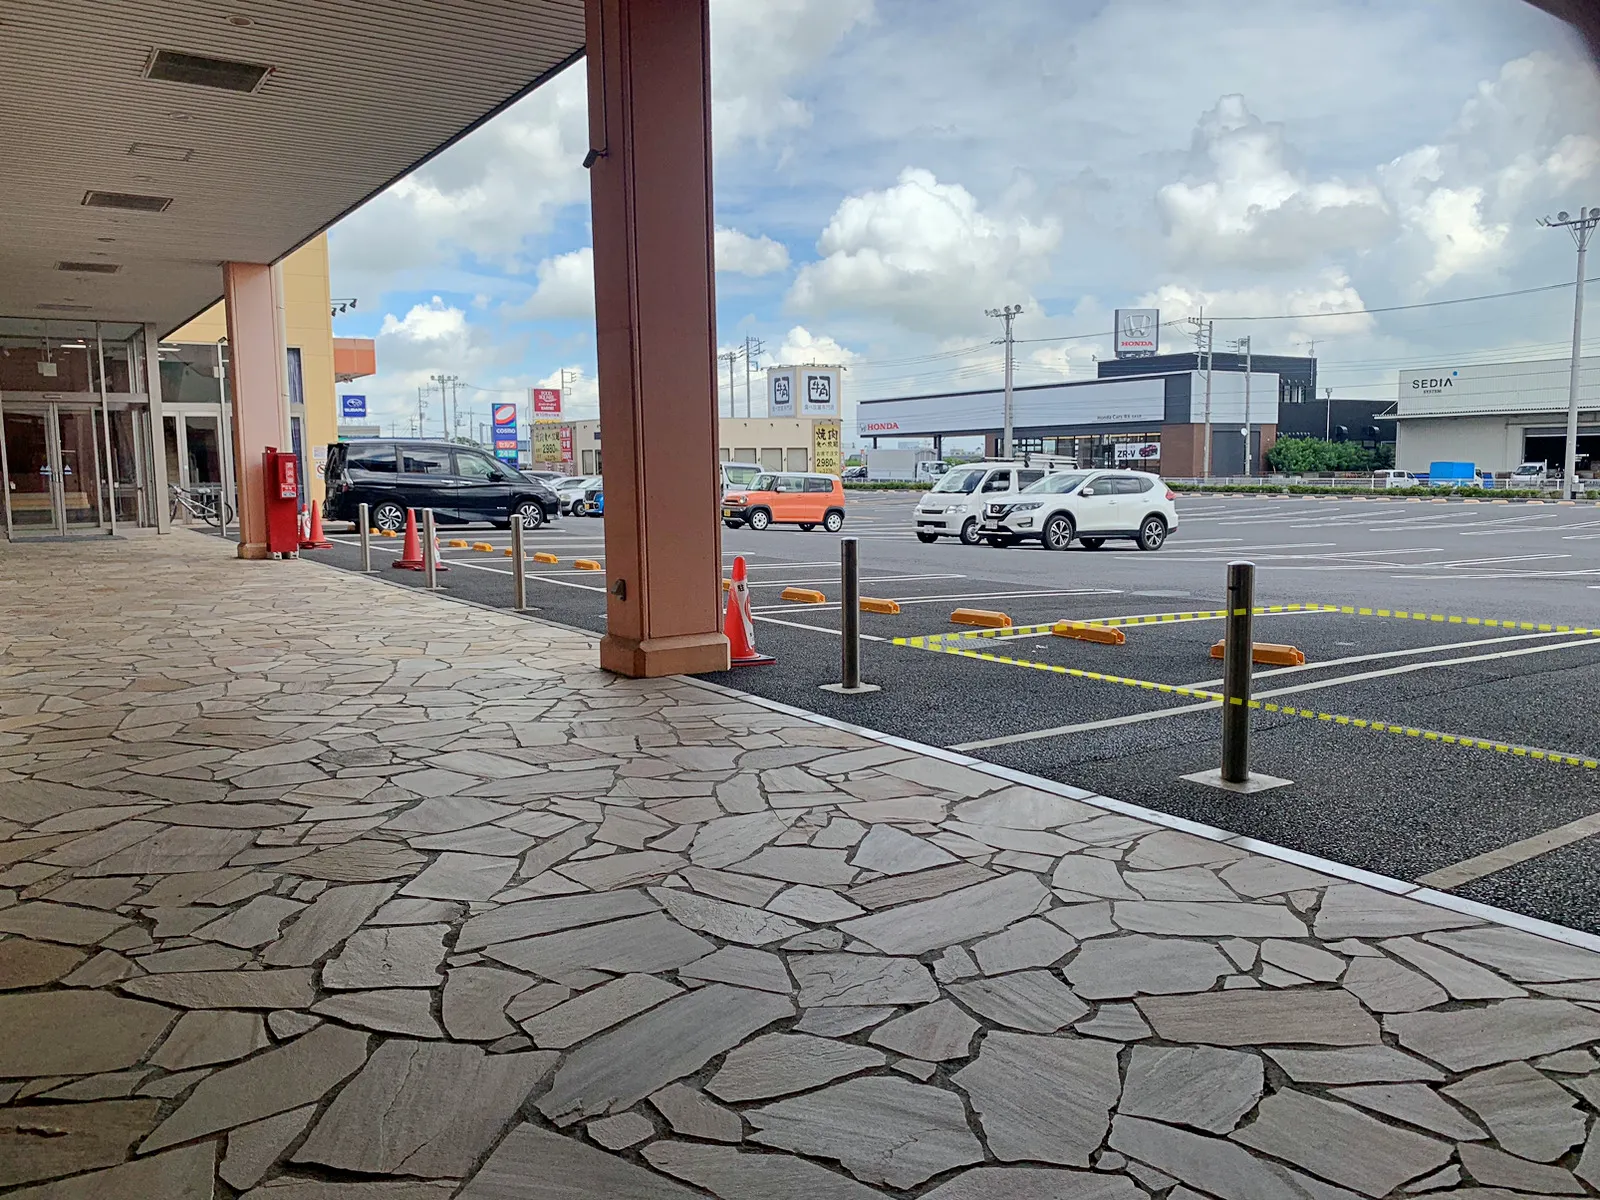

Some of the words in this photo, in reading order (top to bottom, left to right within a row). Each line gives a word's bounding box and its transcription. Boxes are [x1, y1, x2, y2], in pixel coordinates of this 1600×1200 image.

[1412, 377, 1452, 390] SEDIA
[868, 422, 900, 430] HONDA
[815, 428, 838, 441] 焼肉
[1117, 449, 1136, 458] ZR-V
